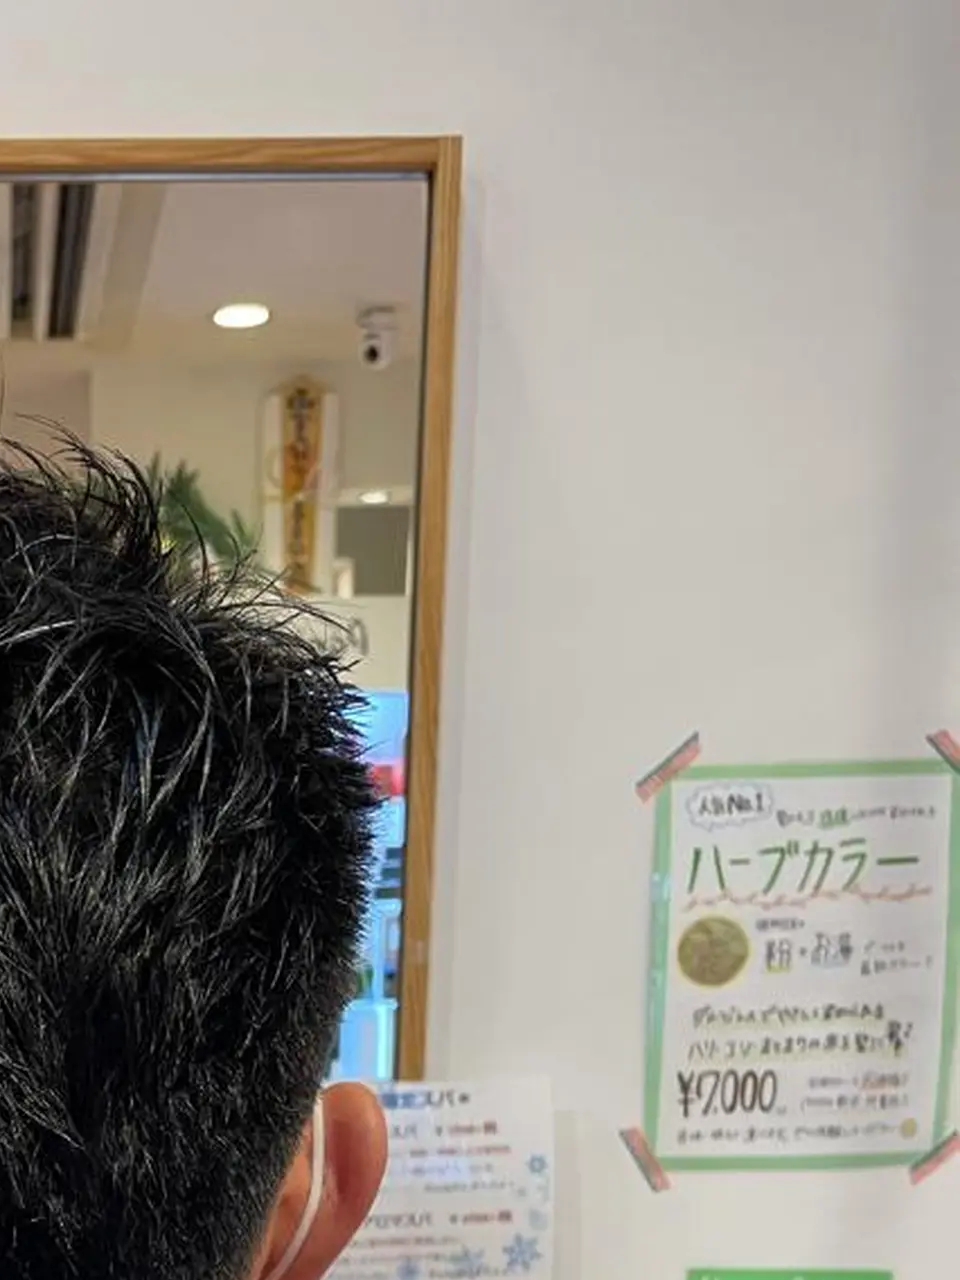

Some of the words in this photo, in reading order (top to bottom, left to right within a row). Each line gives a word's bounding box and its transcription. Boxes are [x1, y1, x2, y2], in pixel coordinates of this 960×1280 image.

[687, 837, 920, 892] ハーブカラー
